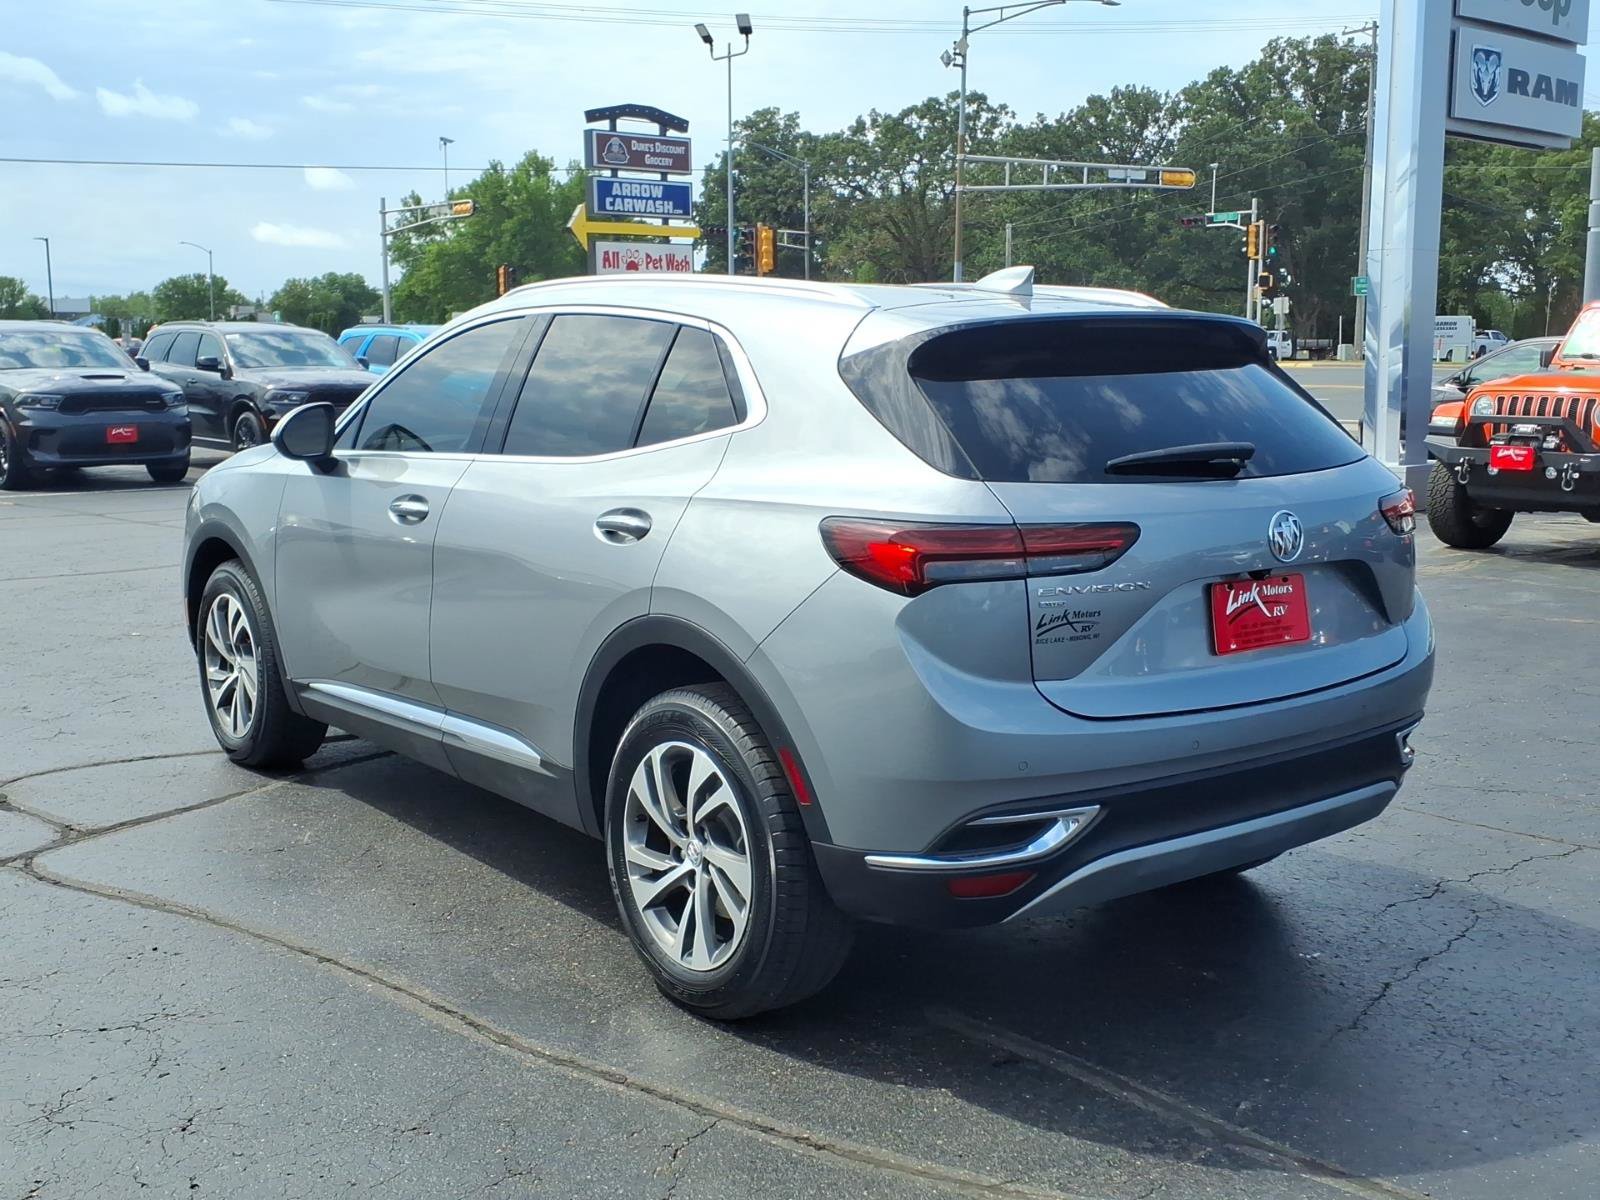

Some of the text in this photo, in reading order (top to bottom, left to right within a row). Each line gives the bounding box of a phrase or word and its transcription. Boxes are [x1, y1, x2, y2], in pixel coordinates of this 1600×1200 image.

[1507, 68, 1577, 107] RAM
[645, 155, 673, 166] GROCERY
[612, 183, 663, 197] ARROW
[602, 251, 690, 272] All Pet Wash
[1038, 581, 1150, 596] ENVISION
[1262, 584, 1293, 597] Motors
[1072, 610, 1101, 619] Motors
[1273, 605, 1288, 616] RV
[1080, 624, 1094, 633] RV
